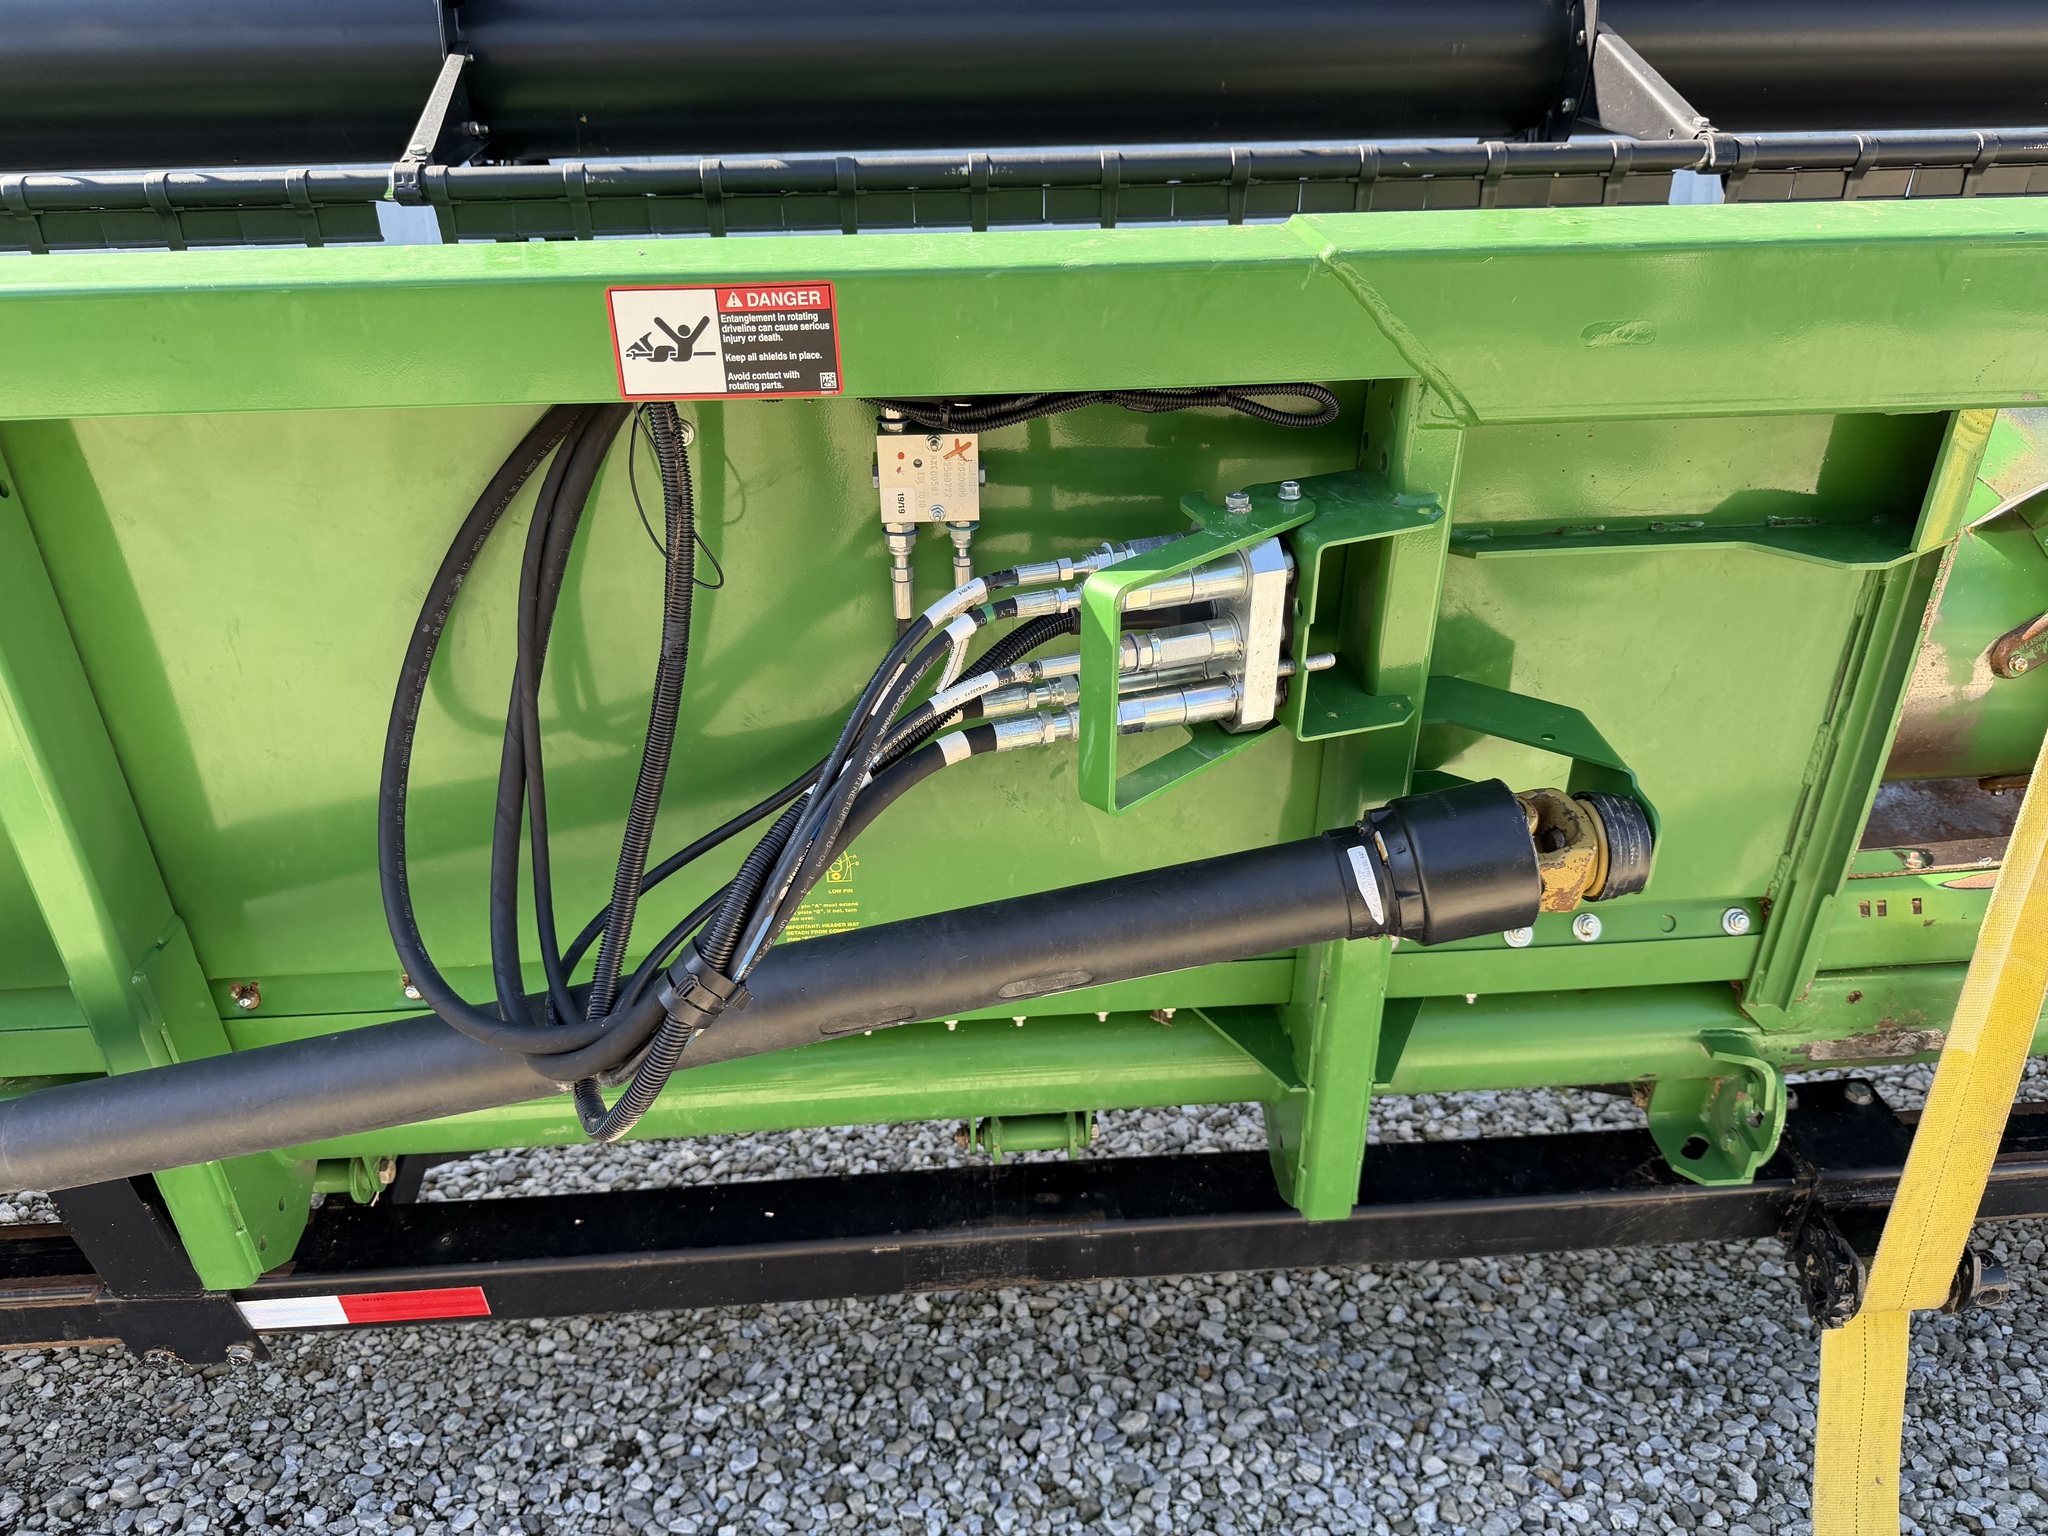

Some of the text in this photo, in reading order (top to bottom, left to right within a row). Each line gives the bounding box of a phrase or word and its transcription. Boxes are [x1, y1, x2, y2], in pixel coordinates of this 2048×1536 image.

[746, 291, 821, 307] DANGER
[720, 311, 819, 324] Entanglement in rotating
[721, 322, 830, 333] driveline can cause serious
[722, 334, 746, 344] injury
[758, 333, 784, 342] death.
[725, 351, 823, 363] Keep all shields in place.
[727, 370, 800, 381] Avoid contact with
[728, 381, 784, 391] rotating parts.
[897, 492, 906, 514] 19/19
[876, 663, 926, 738] ALFAGOMMA
